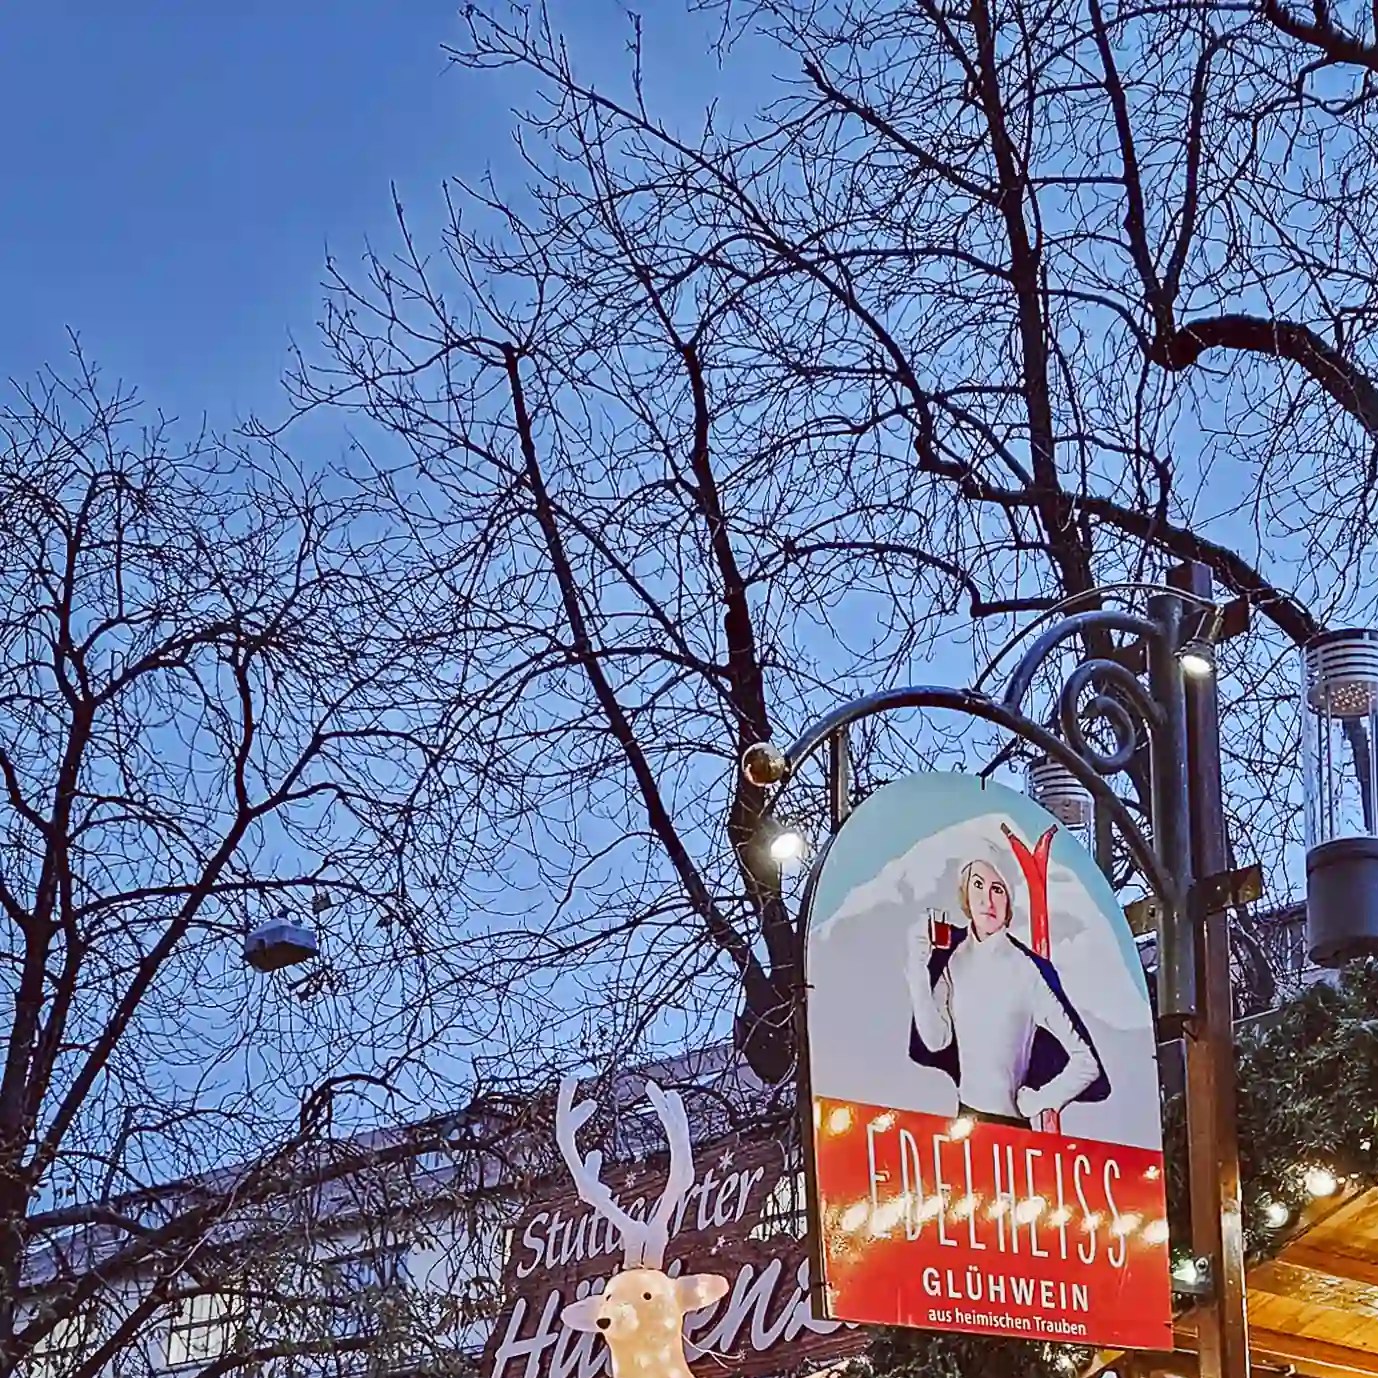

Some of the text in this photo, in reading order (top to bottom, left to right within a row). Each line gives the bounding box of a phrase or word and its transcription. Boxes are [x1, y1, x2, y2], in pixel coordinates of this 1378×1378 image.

[867, 1122, 1128, 1268] EDELHEISS
[922, 1265, 1089, 1312] GLÜHWEIN
[928, 1308, 1087, 1336] aus heimischen Trauben
